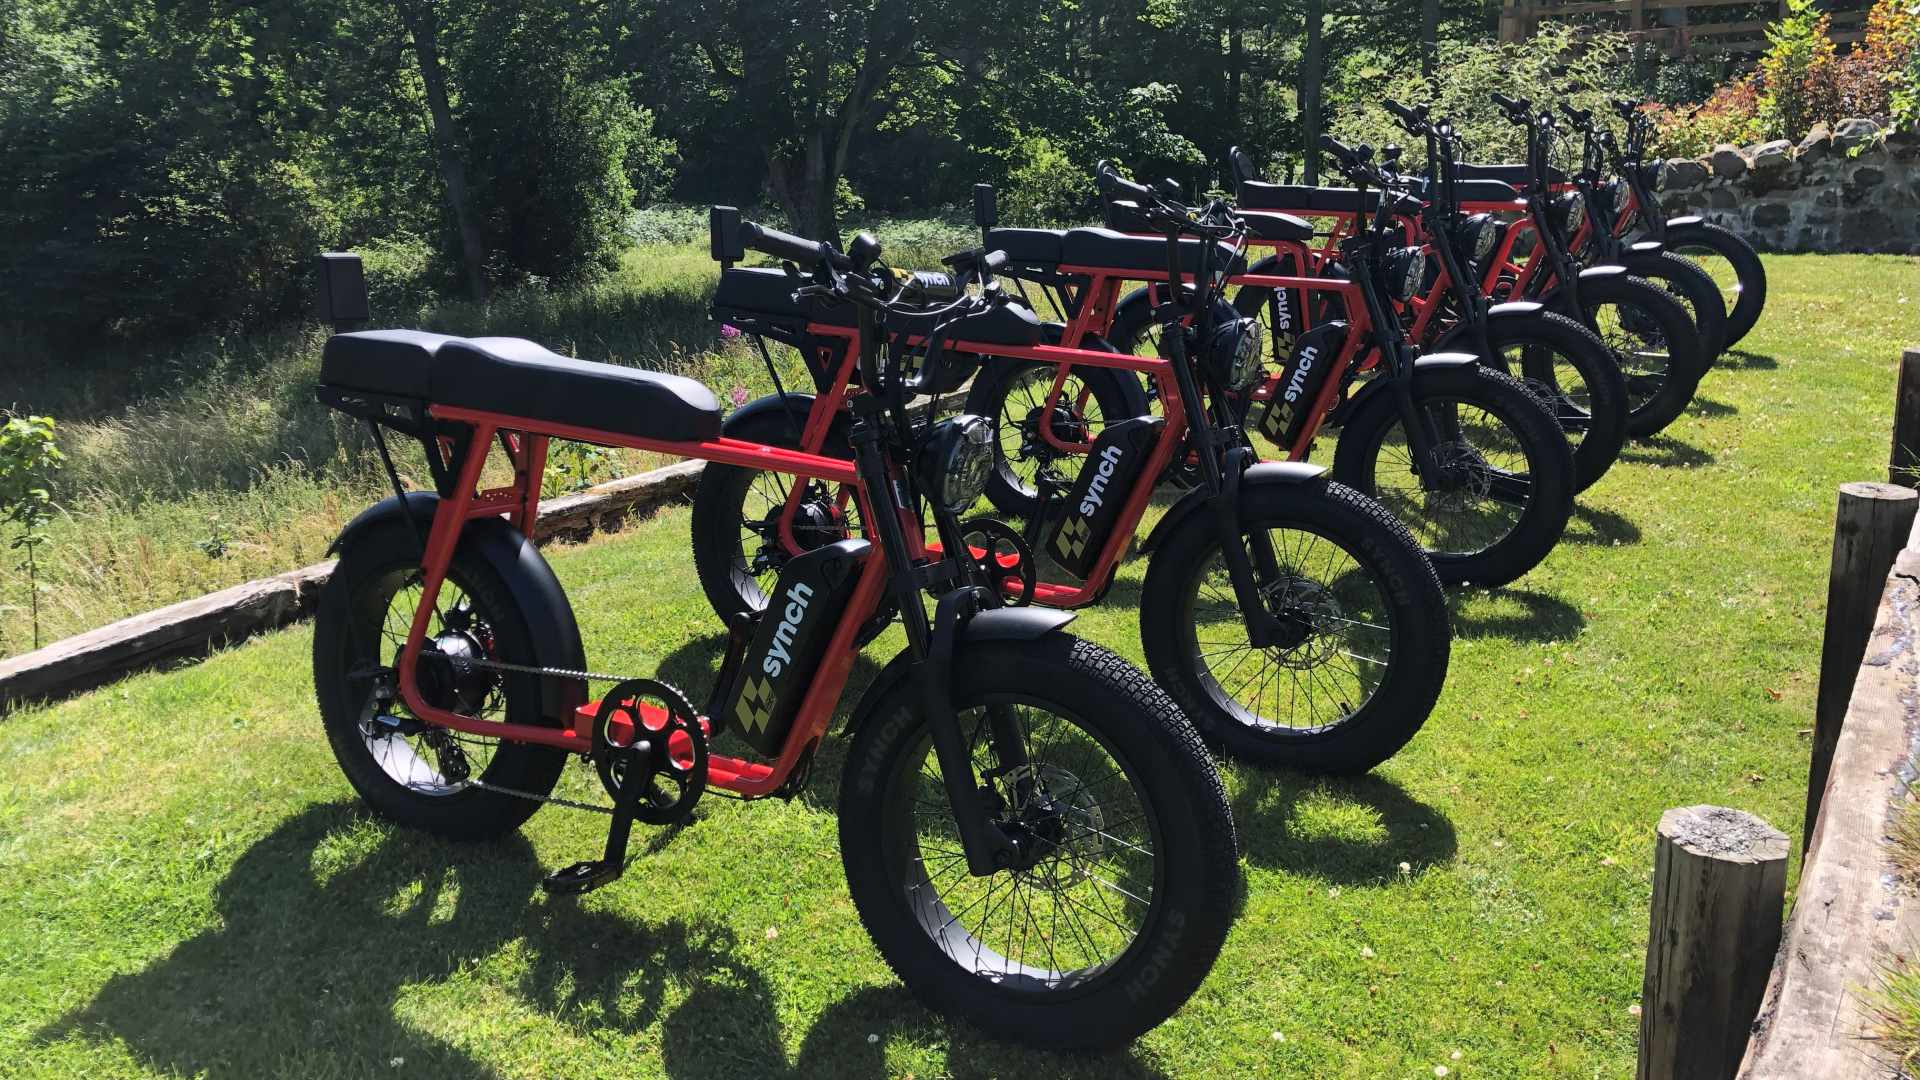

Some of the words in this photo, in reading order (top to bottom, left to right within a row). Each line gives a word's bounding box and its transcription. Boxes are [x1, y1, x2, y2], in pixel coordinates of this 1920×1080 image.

[914, 271, 950, 289] ynch
[1285, 346, 1318, 402] synch
[1080, 445, 1123, 517] synch
[762, 581, 814, 678] synch
[856, 706, 913, 793] SYNCH
[1124, 908, 1185, 1004] SYNCH
